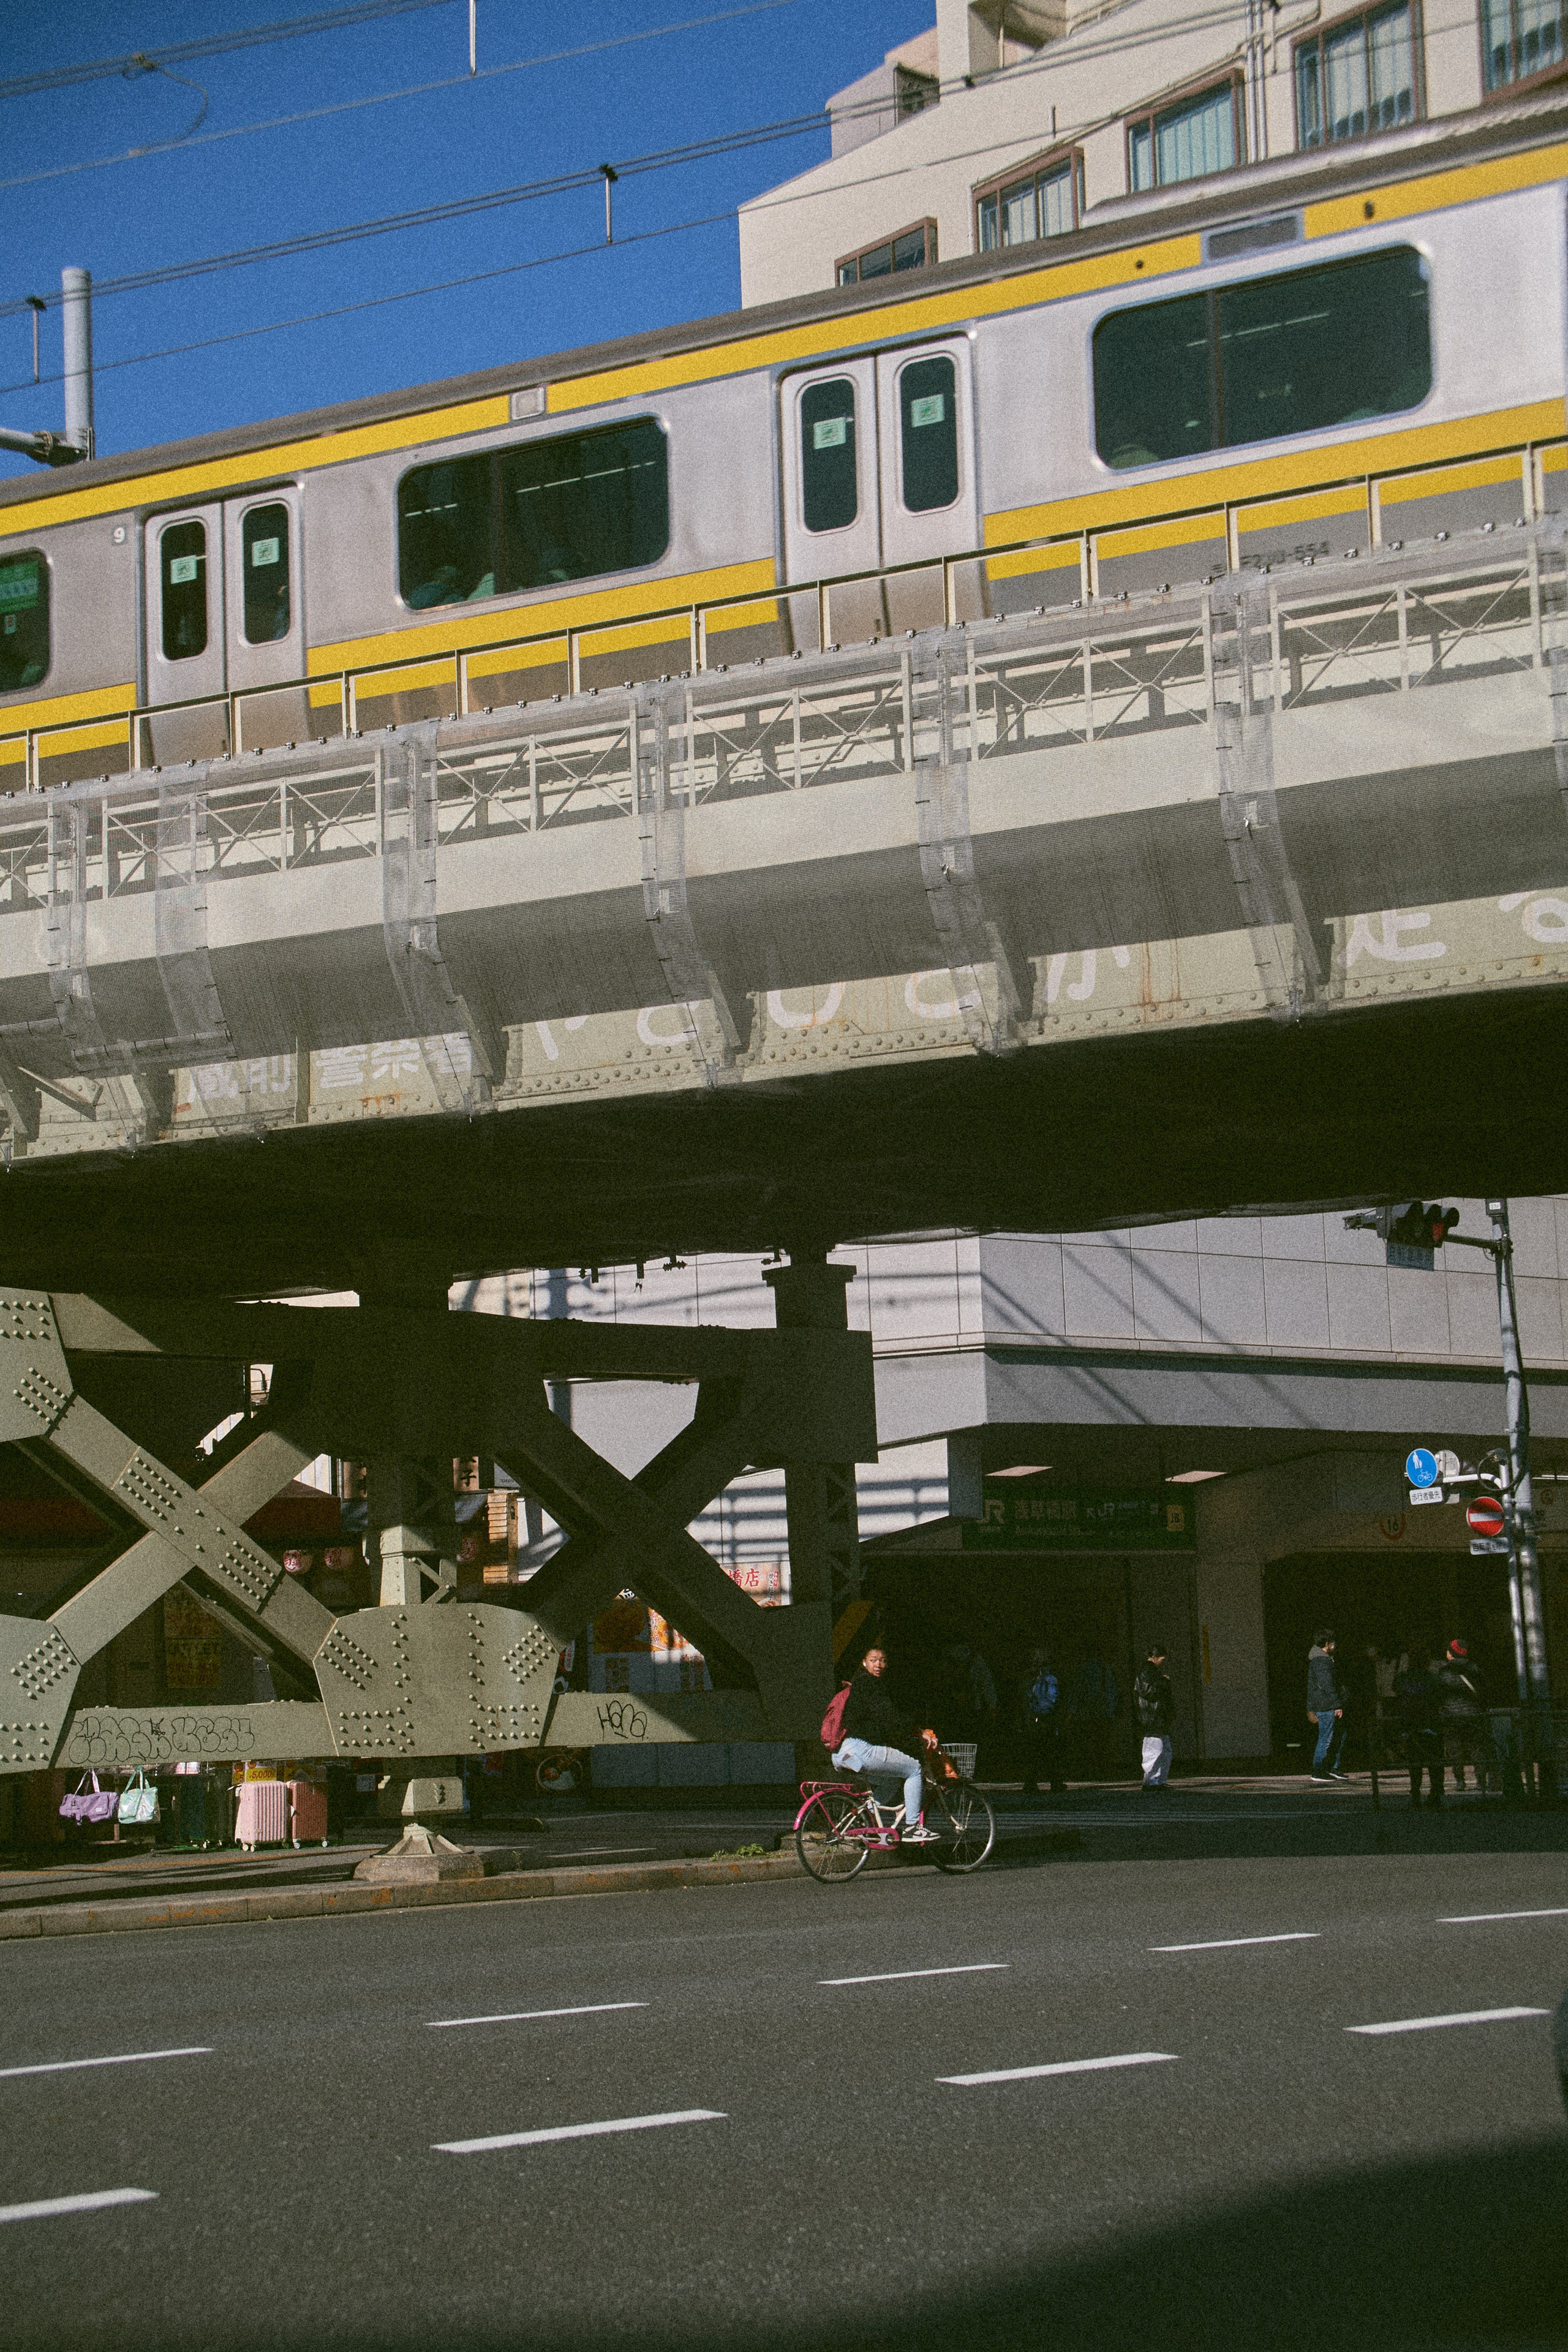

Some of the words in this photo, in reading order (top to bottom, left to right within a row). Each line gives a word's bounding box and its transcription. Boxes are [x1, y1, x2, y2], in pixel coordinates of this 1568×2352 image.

[113, 527, 126, 543] 9
[1411, 1491, 1440, 1502] 歩行者優先
[976, 1499, 1005, 1524] JR
